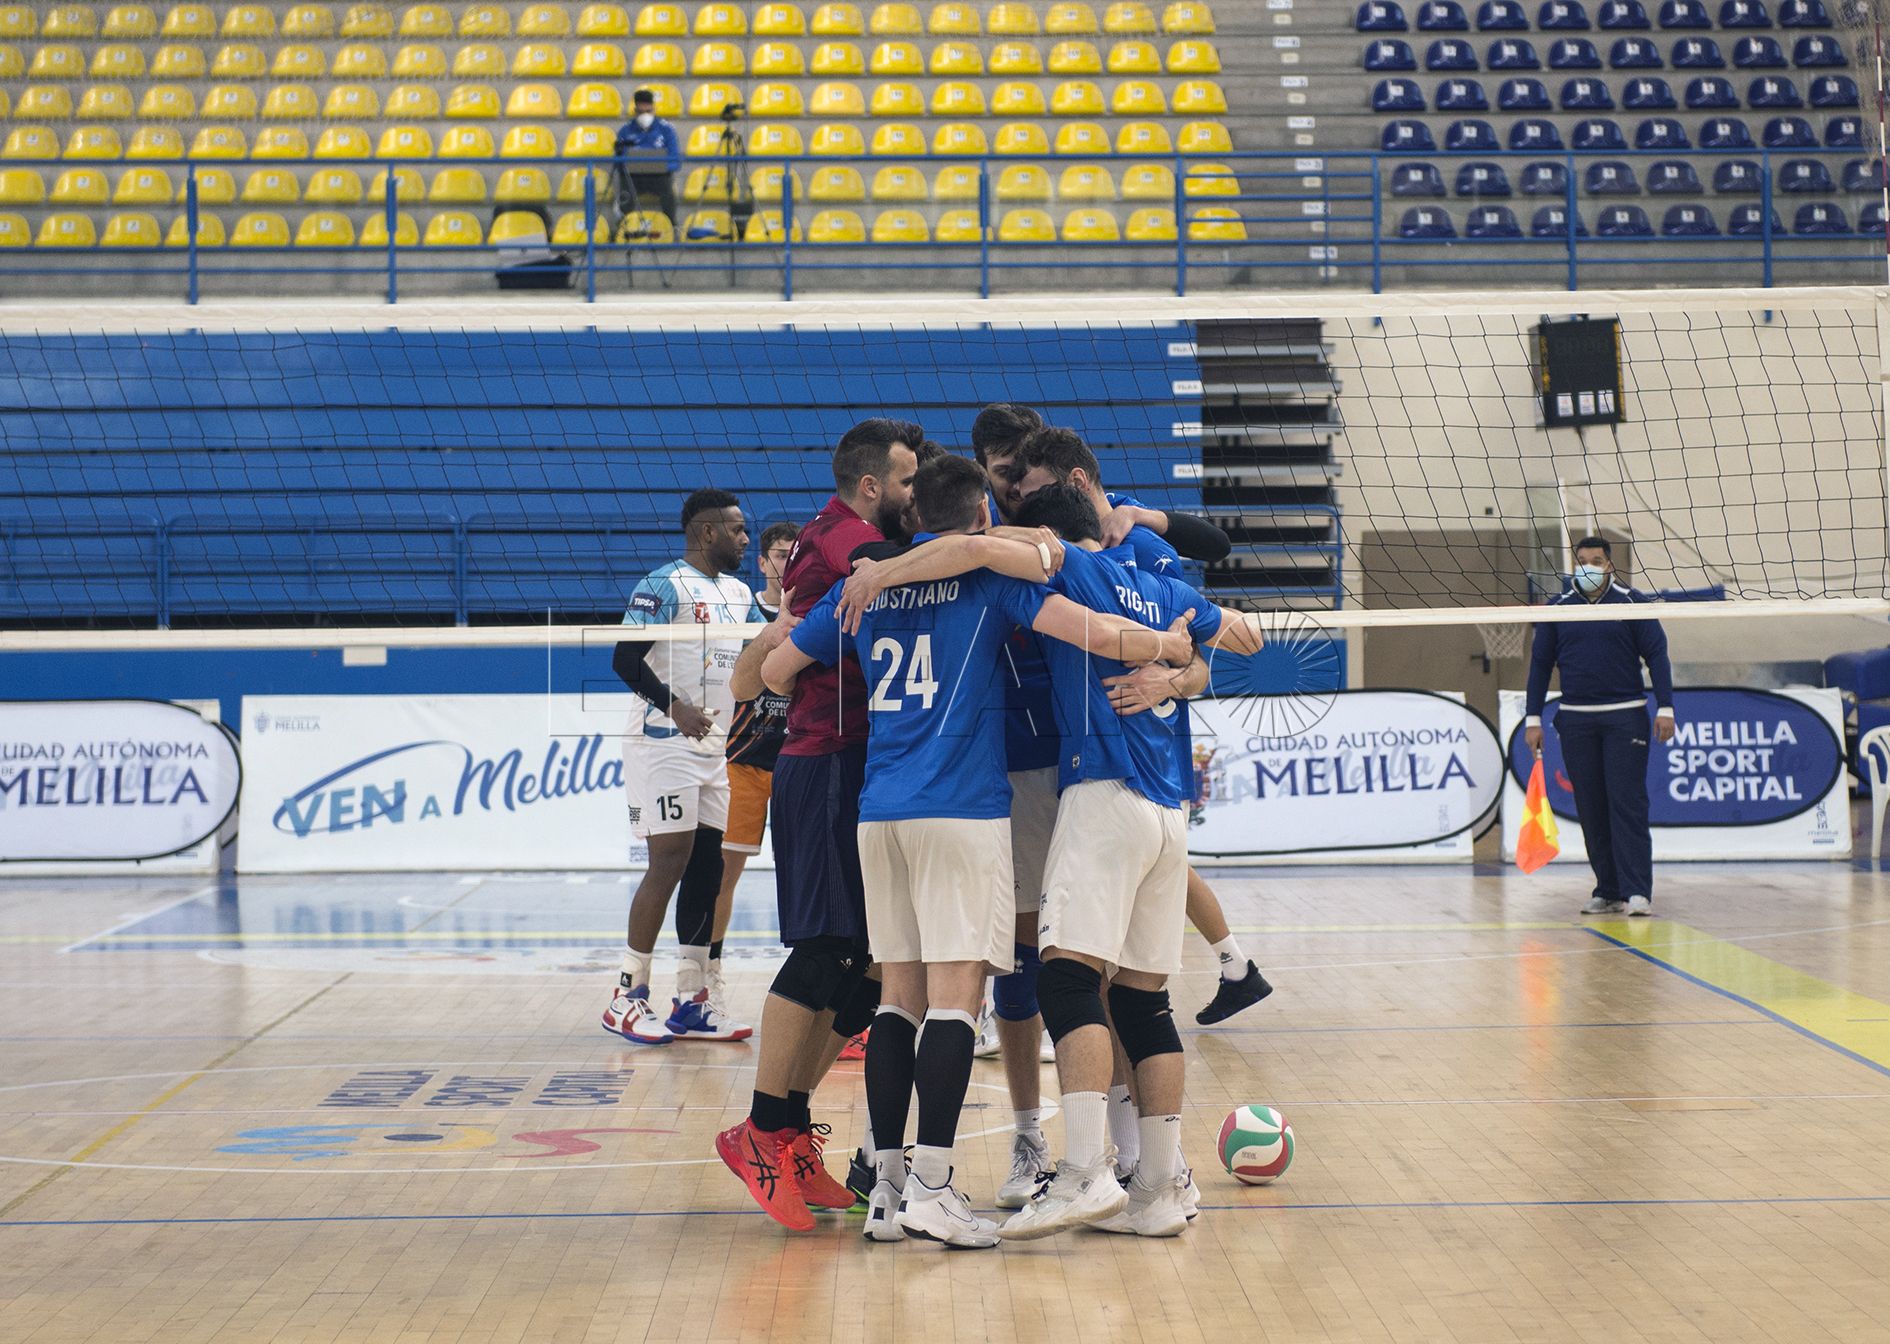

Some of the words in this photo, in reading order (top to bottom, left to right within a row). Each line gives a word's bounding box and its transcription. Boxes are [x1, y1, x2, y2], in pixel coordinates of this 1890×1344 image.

[868, 634, 939, 712] 24
[1246, 733, 1328, 753] CIUDAD
[1336, 725, 1471, 751] AUTÓNOMA
[1666, 720, 1798, 746] MELILLA
[72, 737, 209, 759] AUTÓNOMA
[1268, 757, 1281, 767] DE
[1667, 748, 1774, 775] SPORT
[284, 779, 406, 838] VEN
[418, 795, 442, 821] A
[452, 732, 625, 816] Melilla
[1252, 751, 1478, 800] MELILLA
[1668, 776, 1803, 802] CAPITAL
[656, 794, 684, 822] 15
[423, 1075, 535, 1107] SPORT
